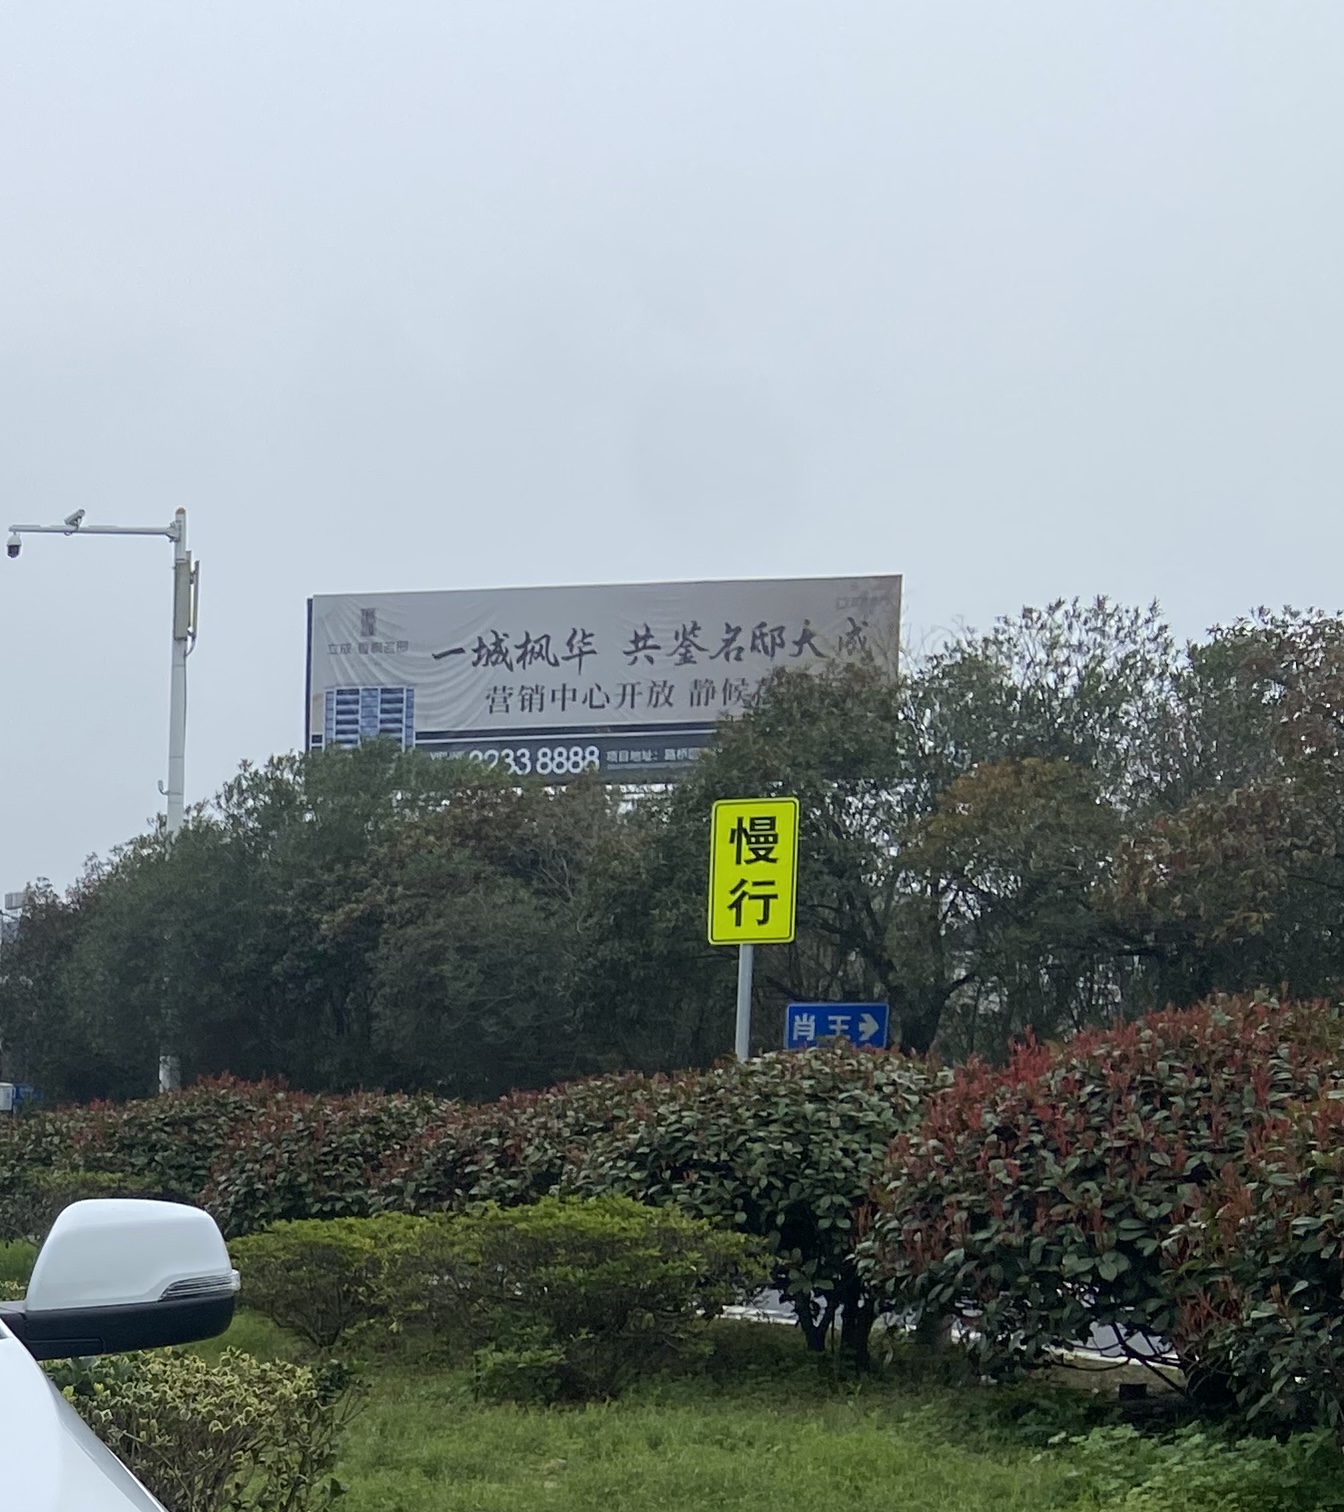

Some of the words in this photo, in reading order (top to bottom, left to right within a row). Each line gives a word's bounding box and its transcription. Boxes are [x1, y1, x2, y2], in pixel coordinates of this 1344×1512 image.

[431, 626, 598, 675] 一城枫华
[486, 678, 673, 715] 营销中心开放
[536, 745, 600, 775] 8888
[728, 815, 778, 927] 慢行
[792, 1012, 852, 1042] 肖王
